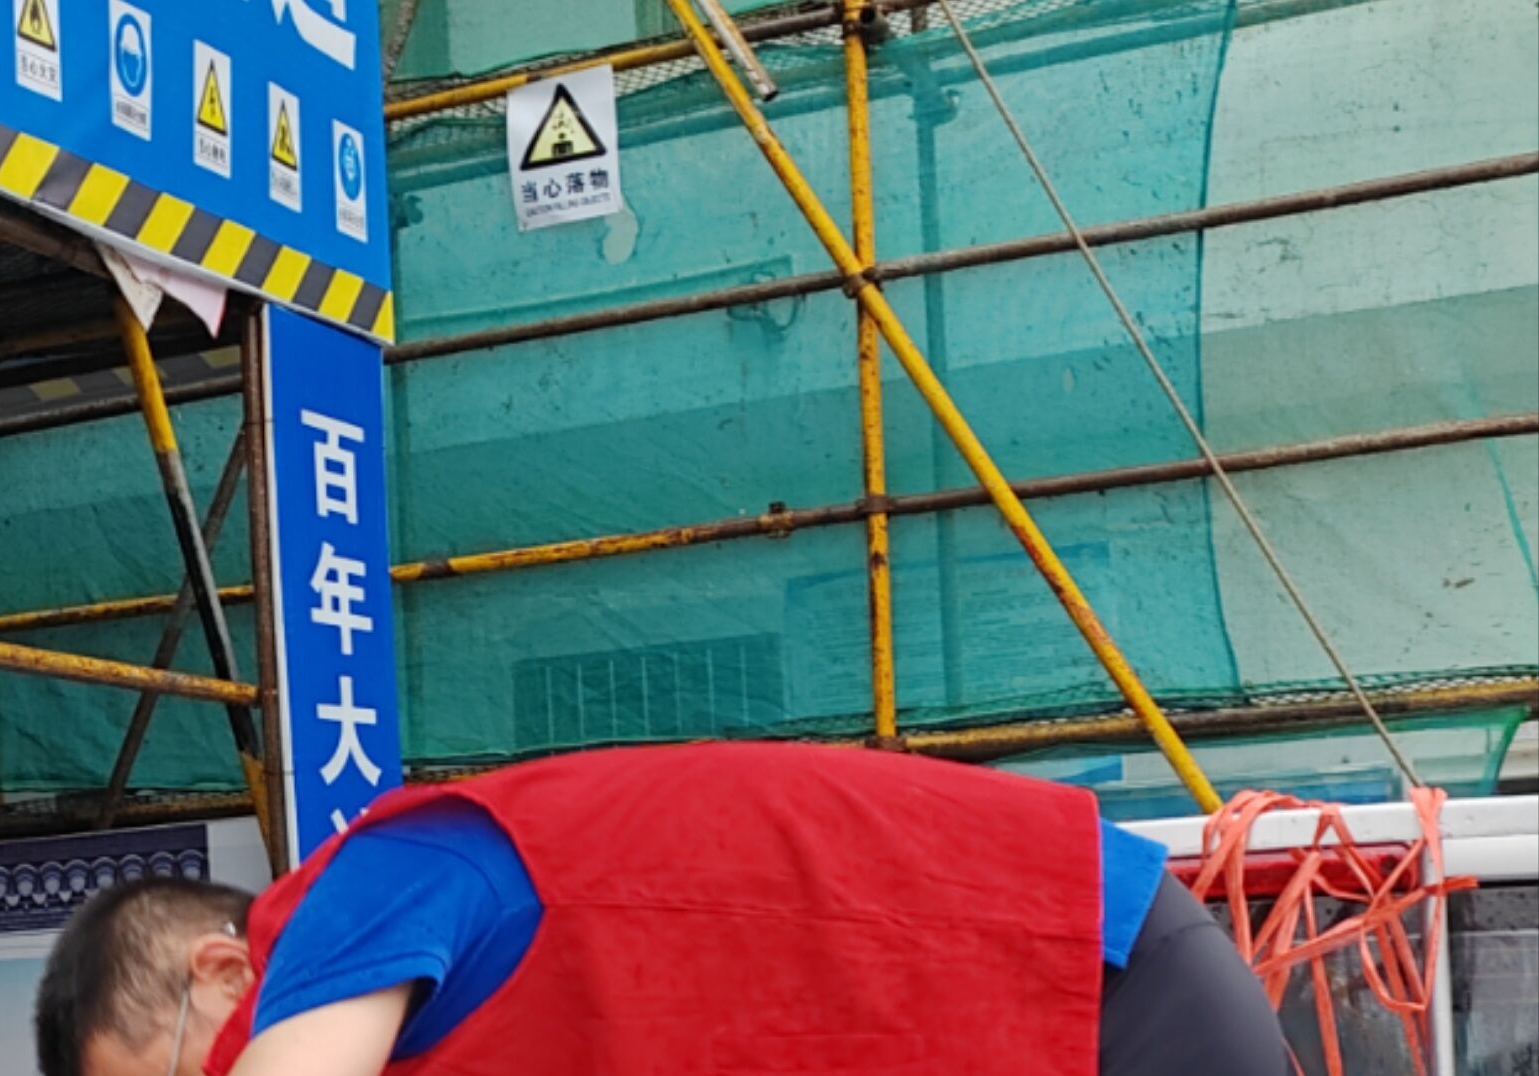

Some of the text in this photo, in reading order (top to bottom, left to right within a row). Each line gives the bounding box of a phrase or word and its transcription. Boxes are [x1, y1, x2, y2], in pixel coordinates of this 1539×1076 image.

[520, 167, 610, 203] 当心落物
[300, 408, 382, 835] 百年大
